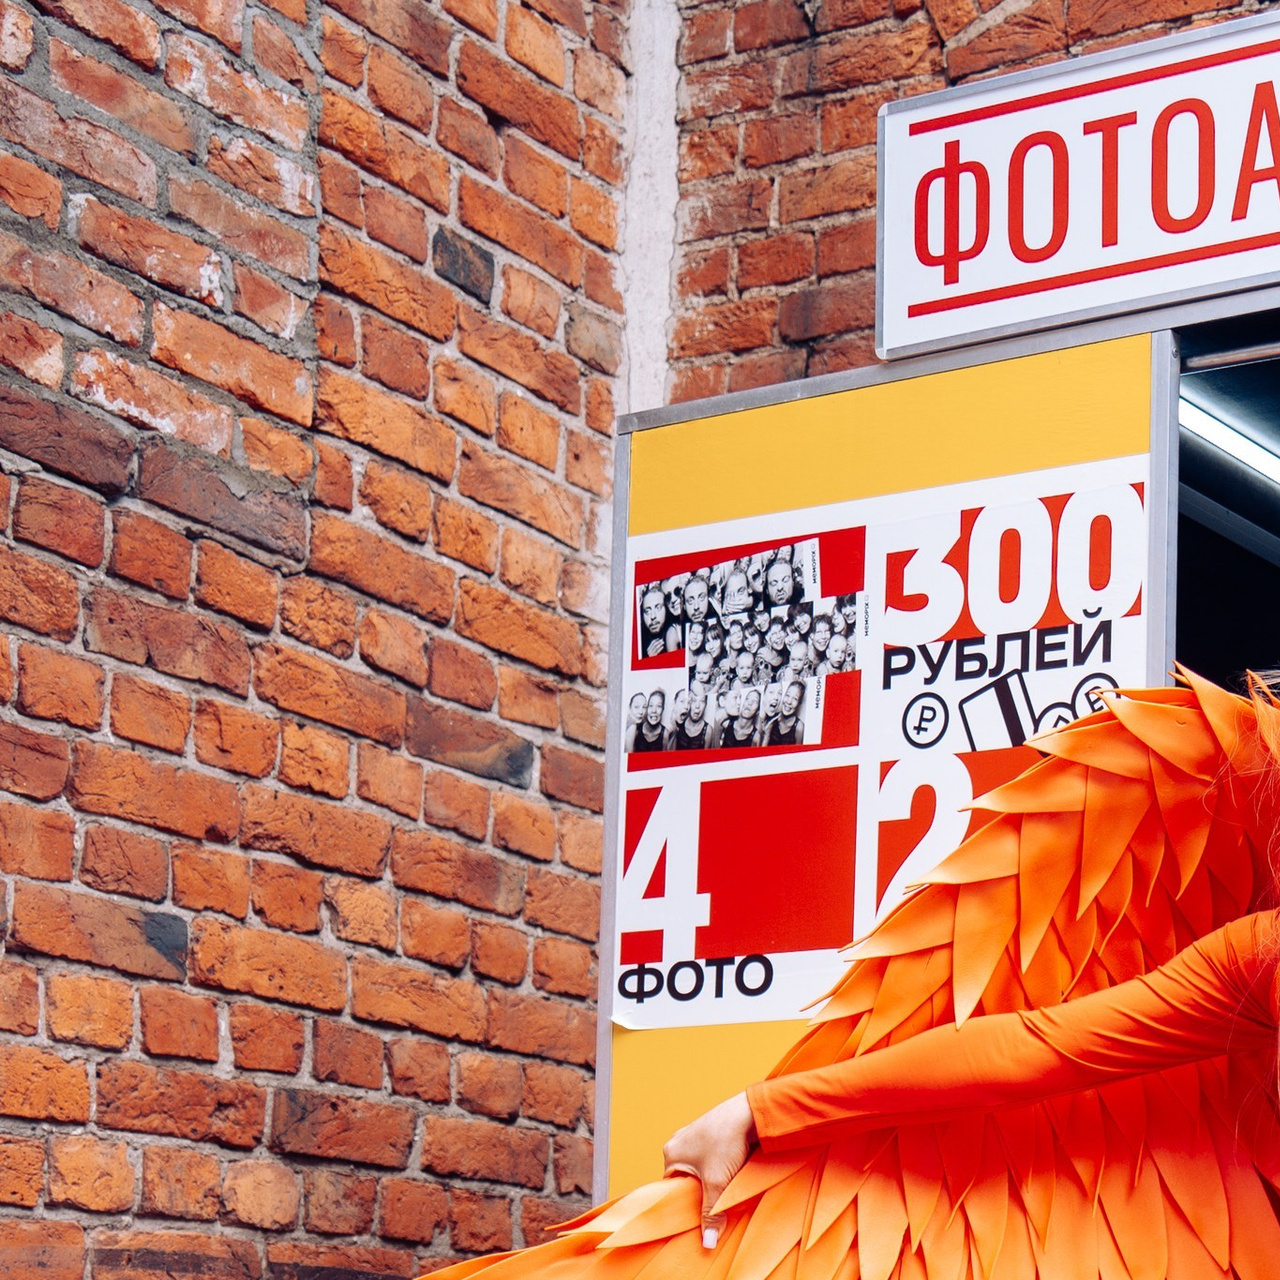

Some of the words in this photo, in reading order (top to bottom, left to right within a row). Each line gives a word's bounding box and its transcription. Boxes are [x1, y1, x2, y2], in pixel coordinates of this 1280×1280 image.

[884, 481, 1144, 646] 300
[882, 606, 1112, 690] РУБЛЕЙ
[621, 781, 711, 965] 4
[618, 954, 774, 1003] ФОТО
